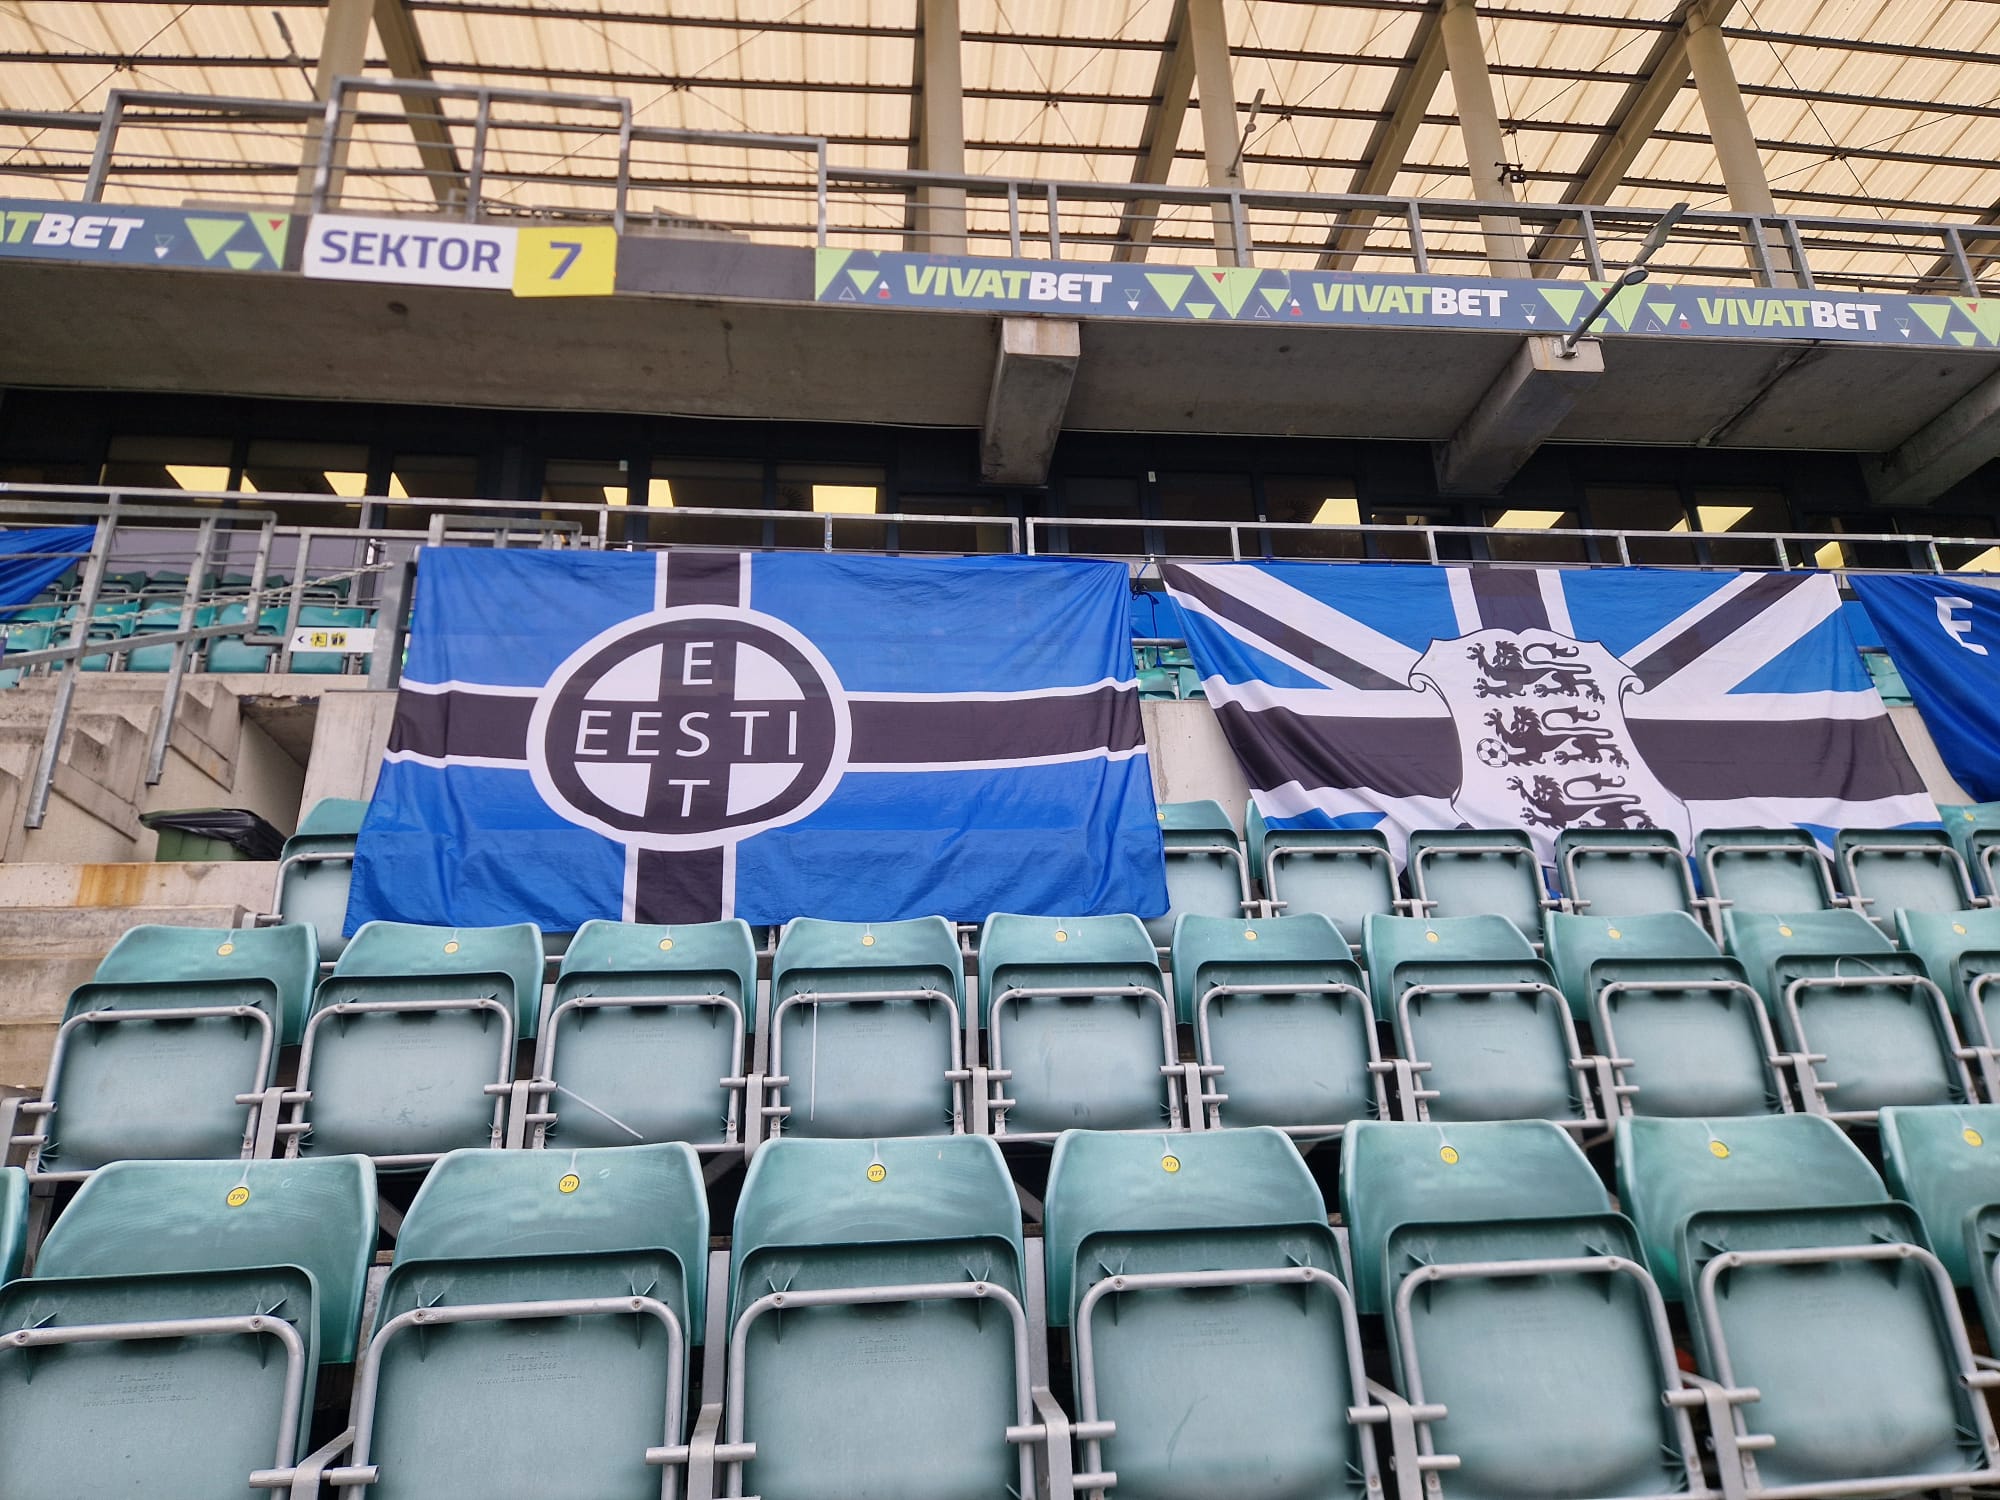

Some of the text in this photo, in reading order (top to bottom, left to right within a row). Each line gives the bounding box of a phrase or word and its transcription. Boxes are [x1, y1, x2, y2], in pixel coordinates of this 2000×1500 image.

[320, 228, 582, 280] SEKTOR 7
[904, 264, 1112, 304] VIVATBET
[1312, 282, 1508, 318] VIVATBET
[1697, 296, 1881, 331] VIVATBET
[575, 710, 797, 757] EESTI
[230, 1192, 246, 1202] 370
[562, 1179, 576, 1188] 371
